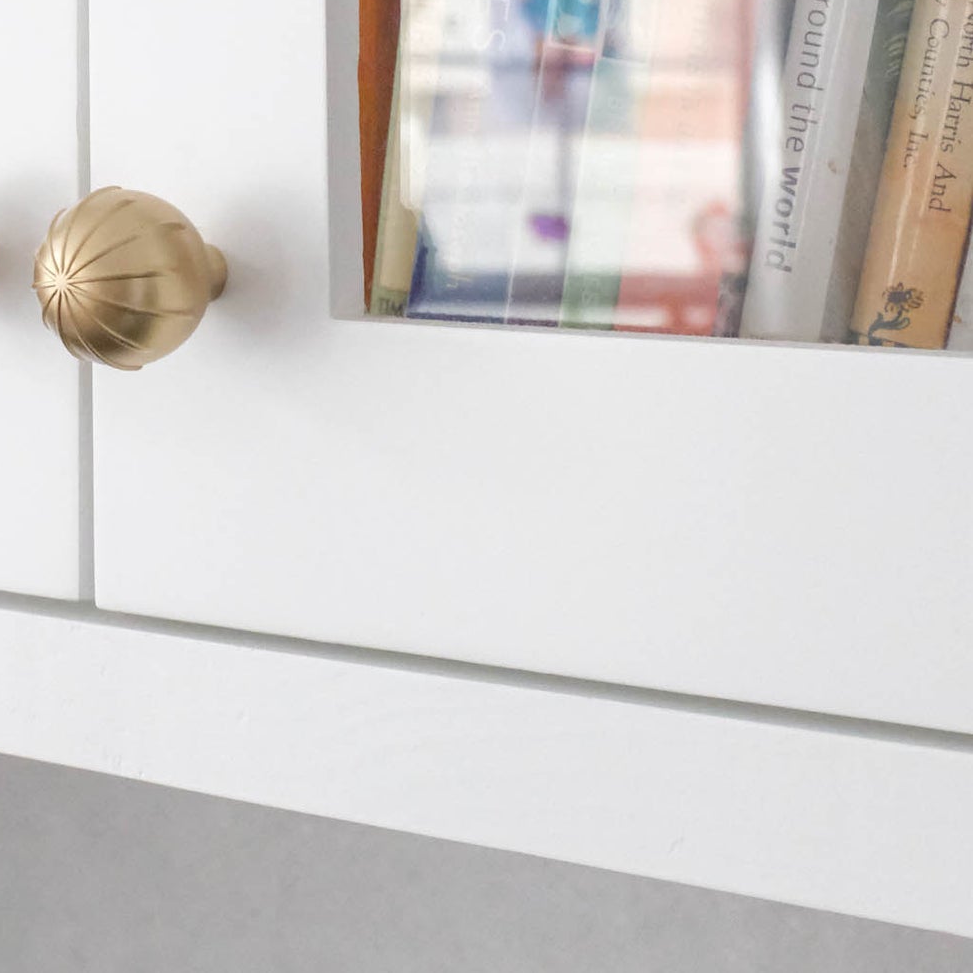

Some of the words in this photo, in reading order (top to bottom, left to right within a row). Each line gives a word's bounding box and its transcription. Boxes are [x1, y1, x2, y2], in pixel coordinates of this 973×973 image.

[908, 16, 950, 120] Counties,
[785, 103, 818, 154] the
[941, 80, 973, 153] Harris
[903, 129, 929, 169] Inc.
[928, 161, 958, 213] And
[763, 166, 801, 274] world
